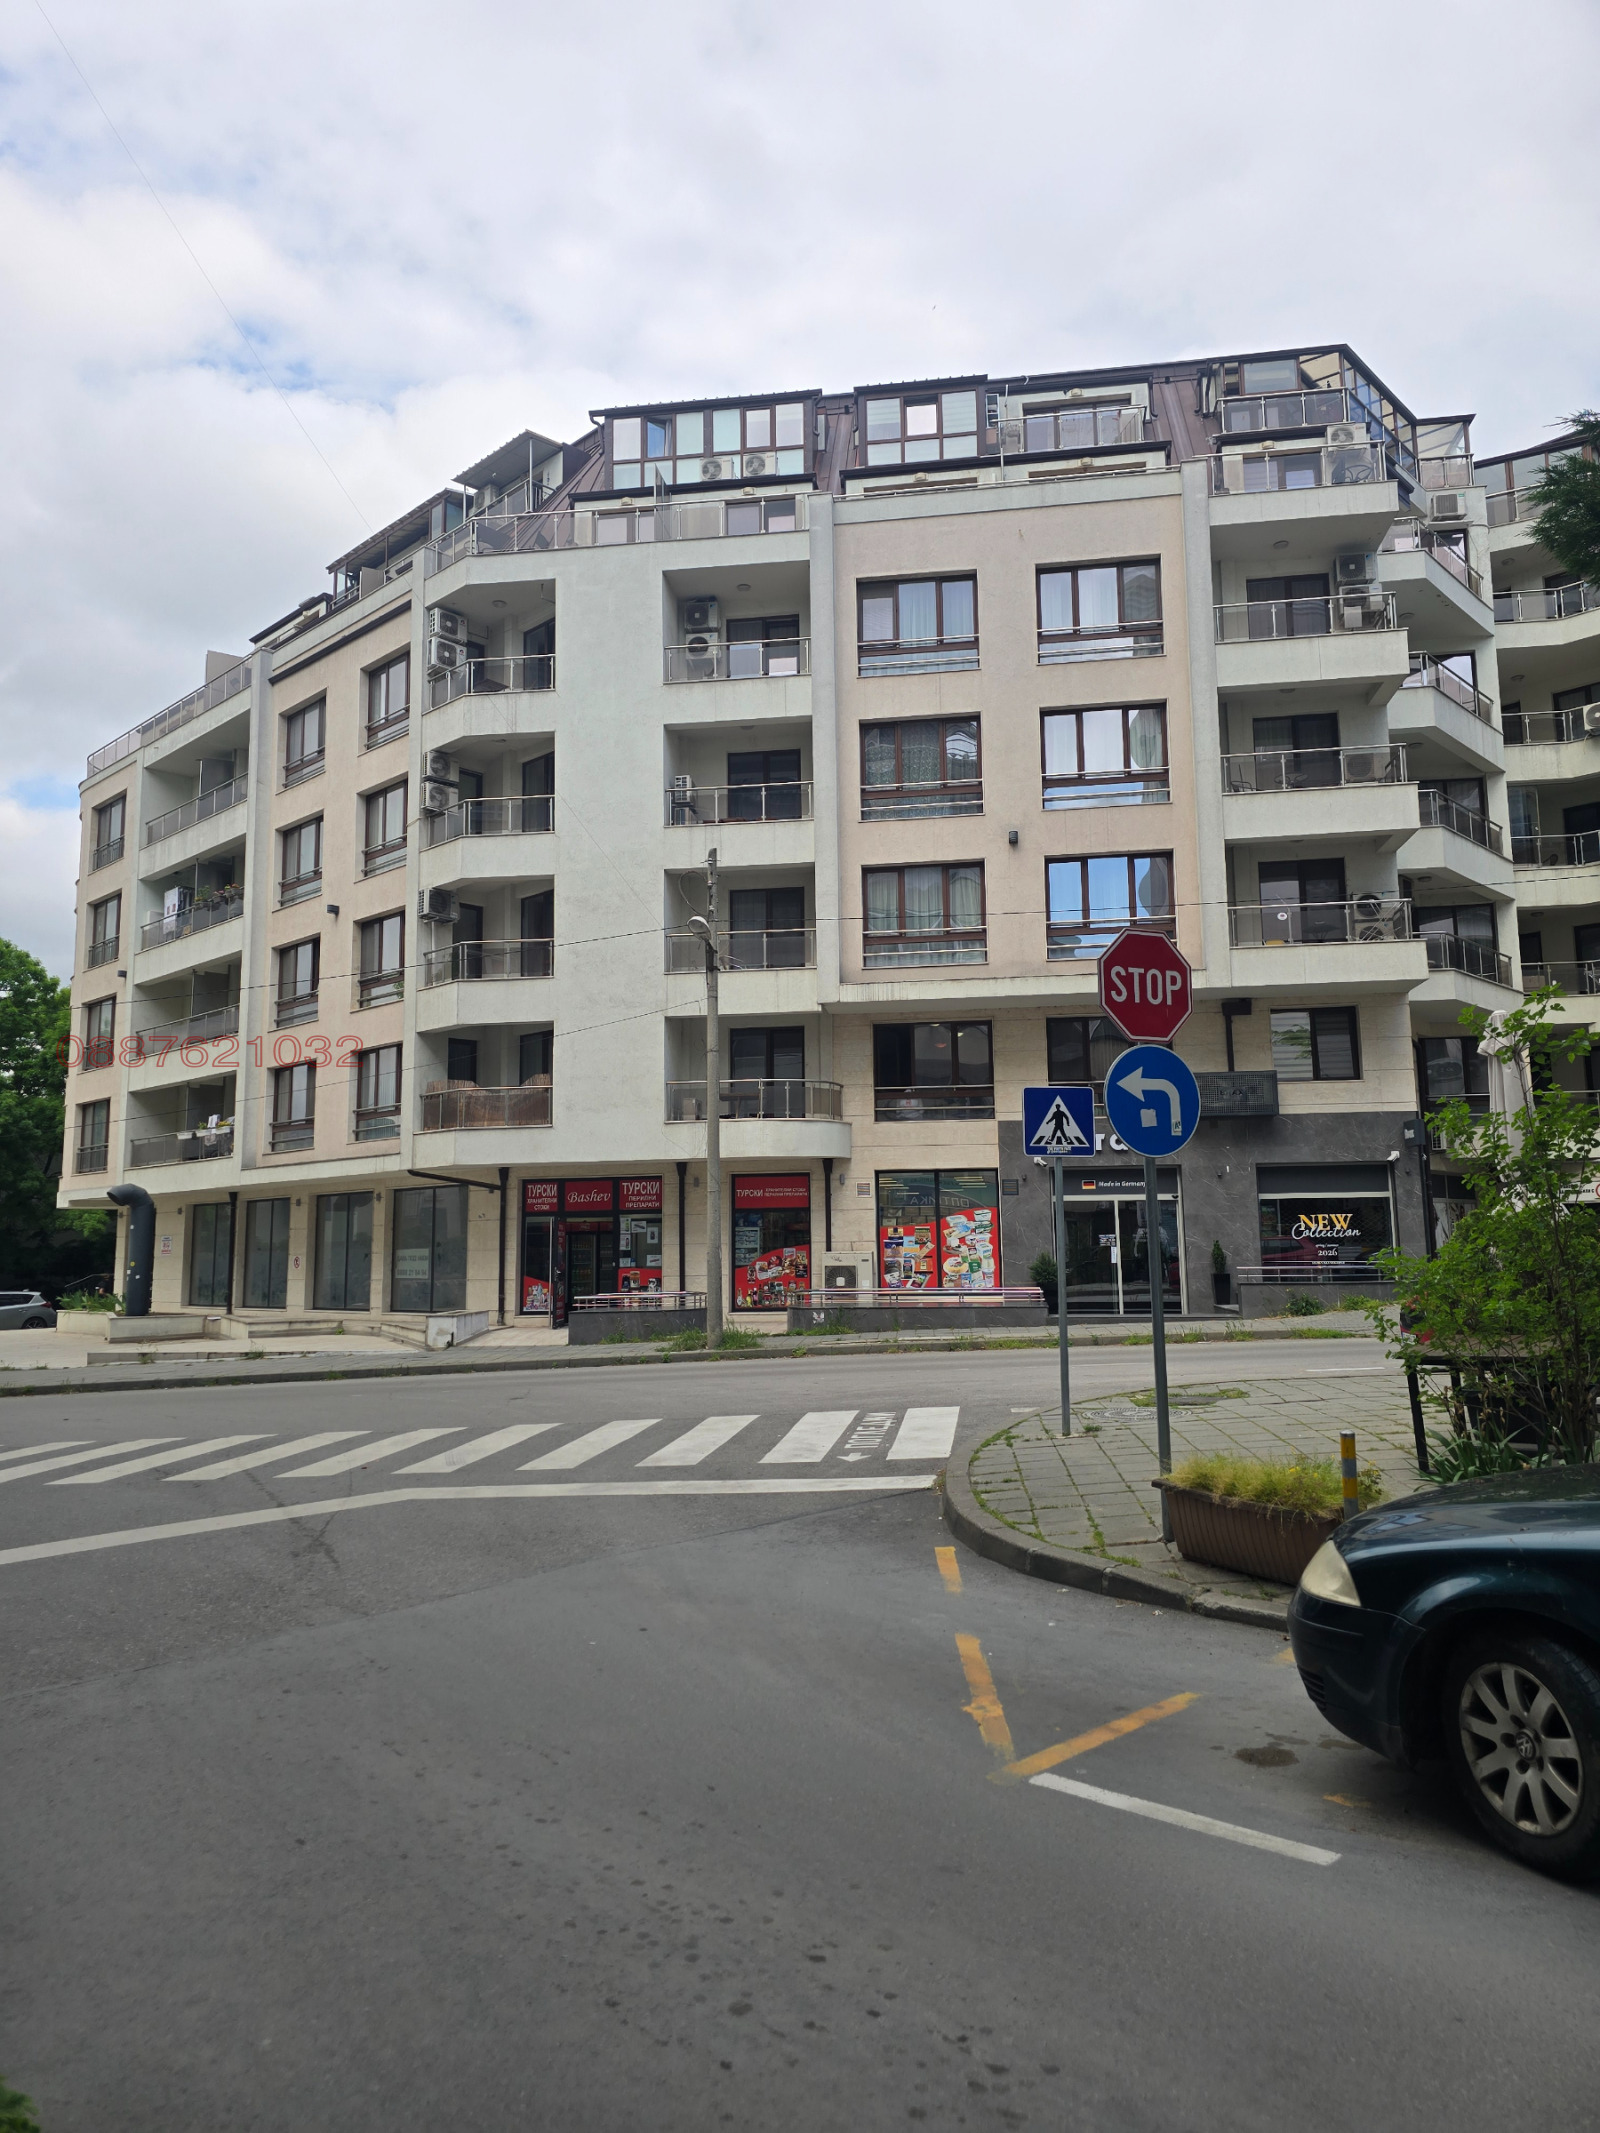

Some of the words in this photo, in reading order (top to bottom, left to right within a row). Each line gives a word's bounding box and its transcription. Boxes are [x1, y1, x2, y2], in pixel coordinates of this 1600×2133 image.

[1110, 965, 1182, 1006] STOP
[527, 1184, 557, 1197] ТУРСКИ
[622, 1181, 660, 1195] ТУРСКИ
[736, 1189, 764, 1197] ТУРСКИ
[567, 1189, 611, 1203] Bashev
[1298, 1213, 1353, 1231] NEW
[1291, 1222, 1362, 1240] Collection
[1317, 1247, 1338, 1256] 2026
